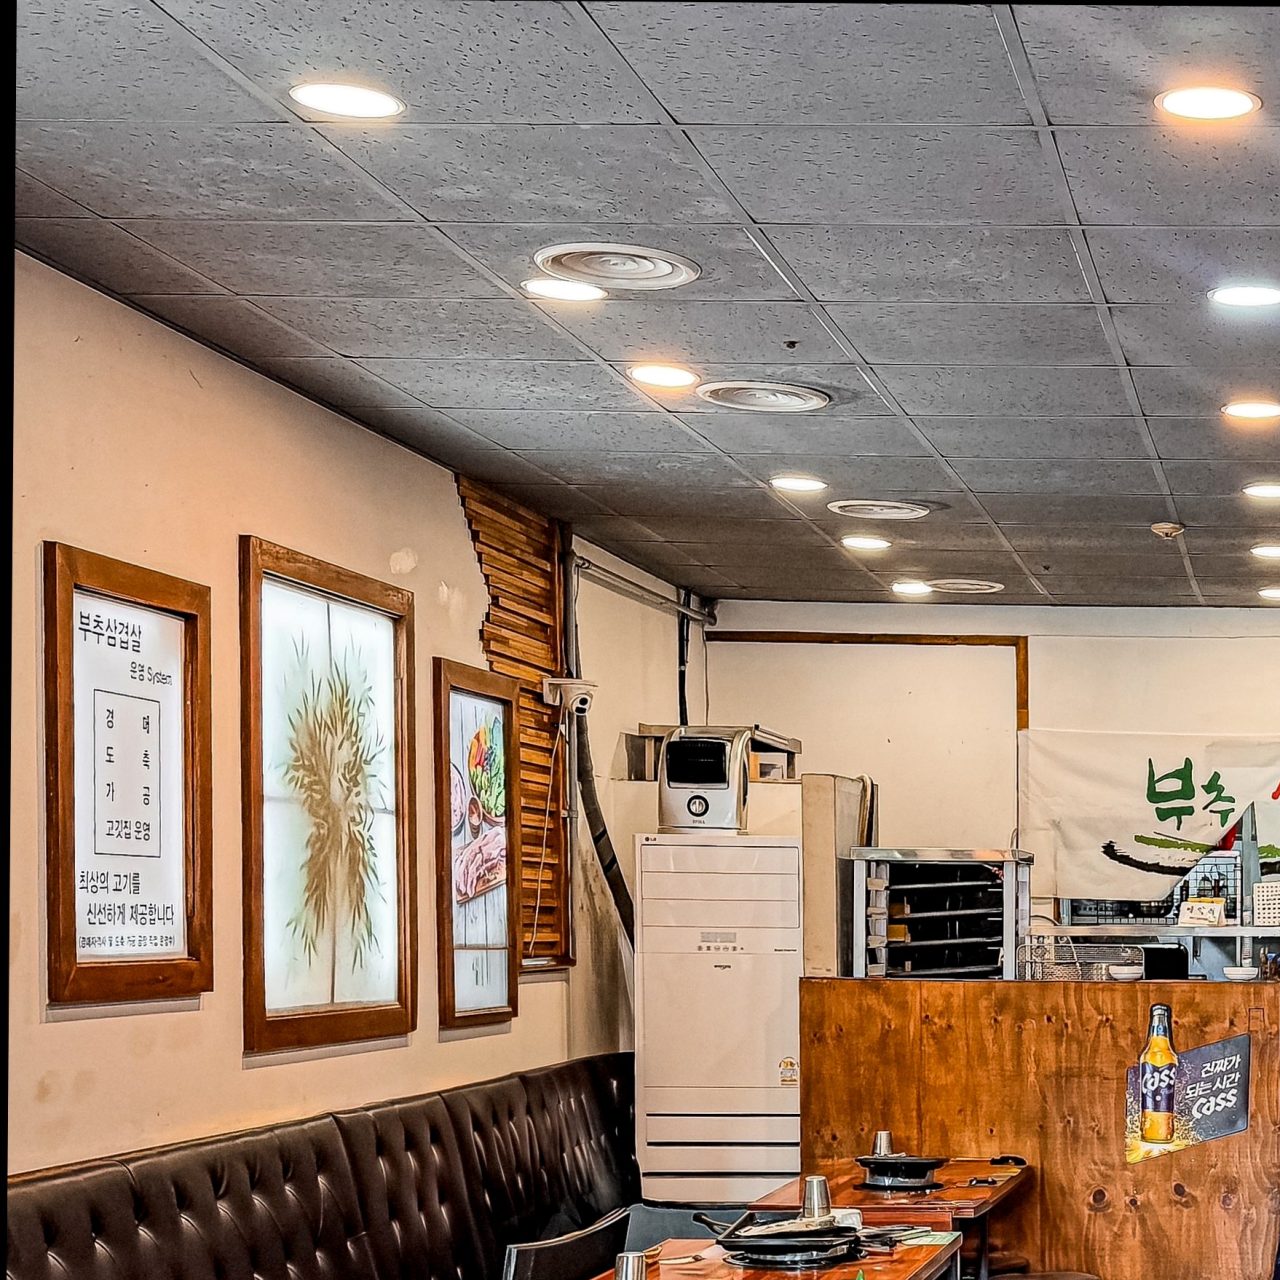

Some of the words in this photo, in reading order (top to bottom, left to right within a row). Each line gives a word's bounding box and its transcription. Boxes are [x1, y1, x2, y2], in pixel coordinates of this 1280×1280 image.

[78, 610, 142, 654] 부추삼겹살
[130, 661, 145, 682] 운영
[1146, 757, 1236, 831] 부추
[105, 819, 132, 839] 고깃집
[134, 820, 151, 842] 운영
[79, 870, 109, 895] 최상의
[112, 872, 141, 895] 고기를
[86, 902, 126, 926] 신선하게
[129, 903, 174, 926] 제공합니다
[1201, 1054, 1241, 1078] 진짜가
[1185, 1080, 1213, 1100] 되는
[1212, 1072, 1242, 1091] 시간
